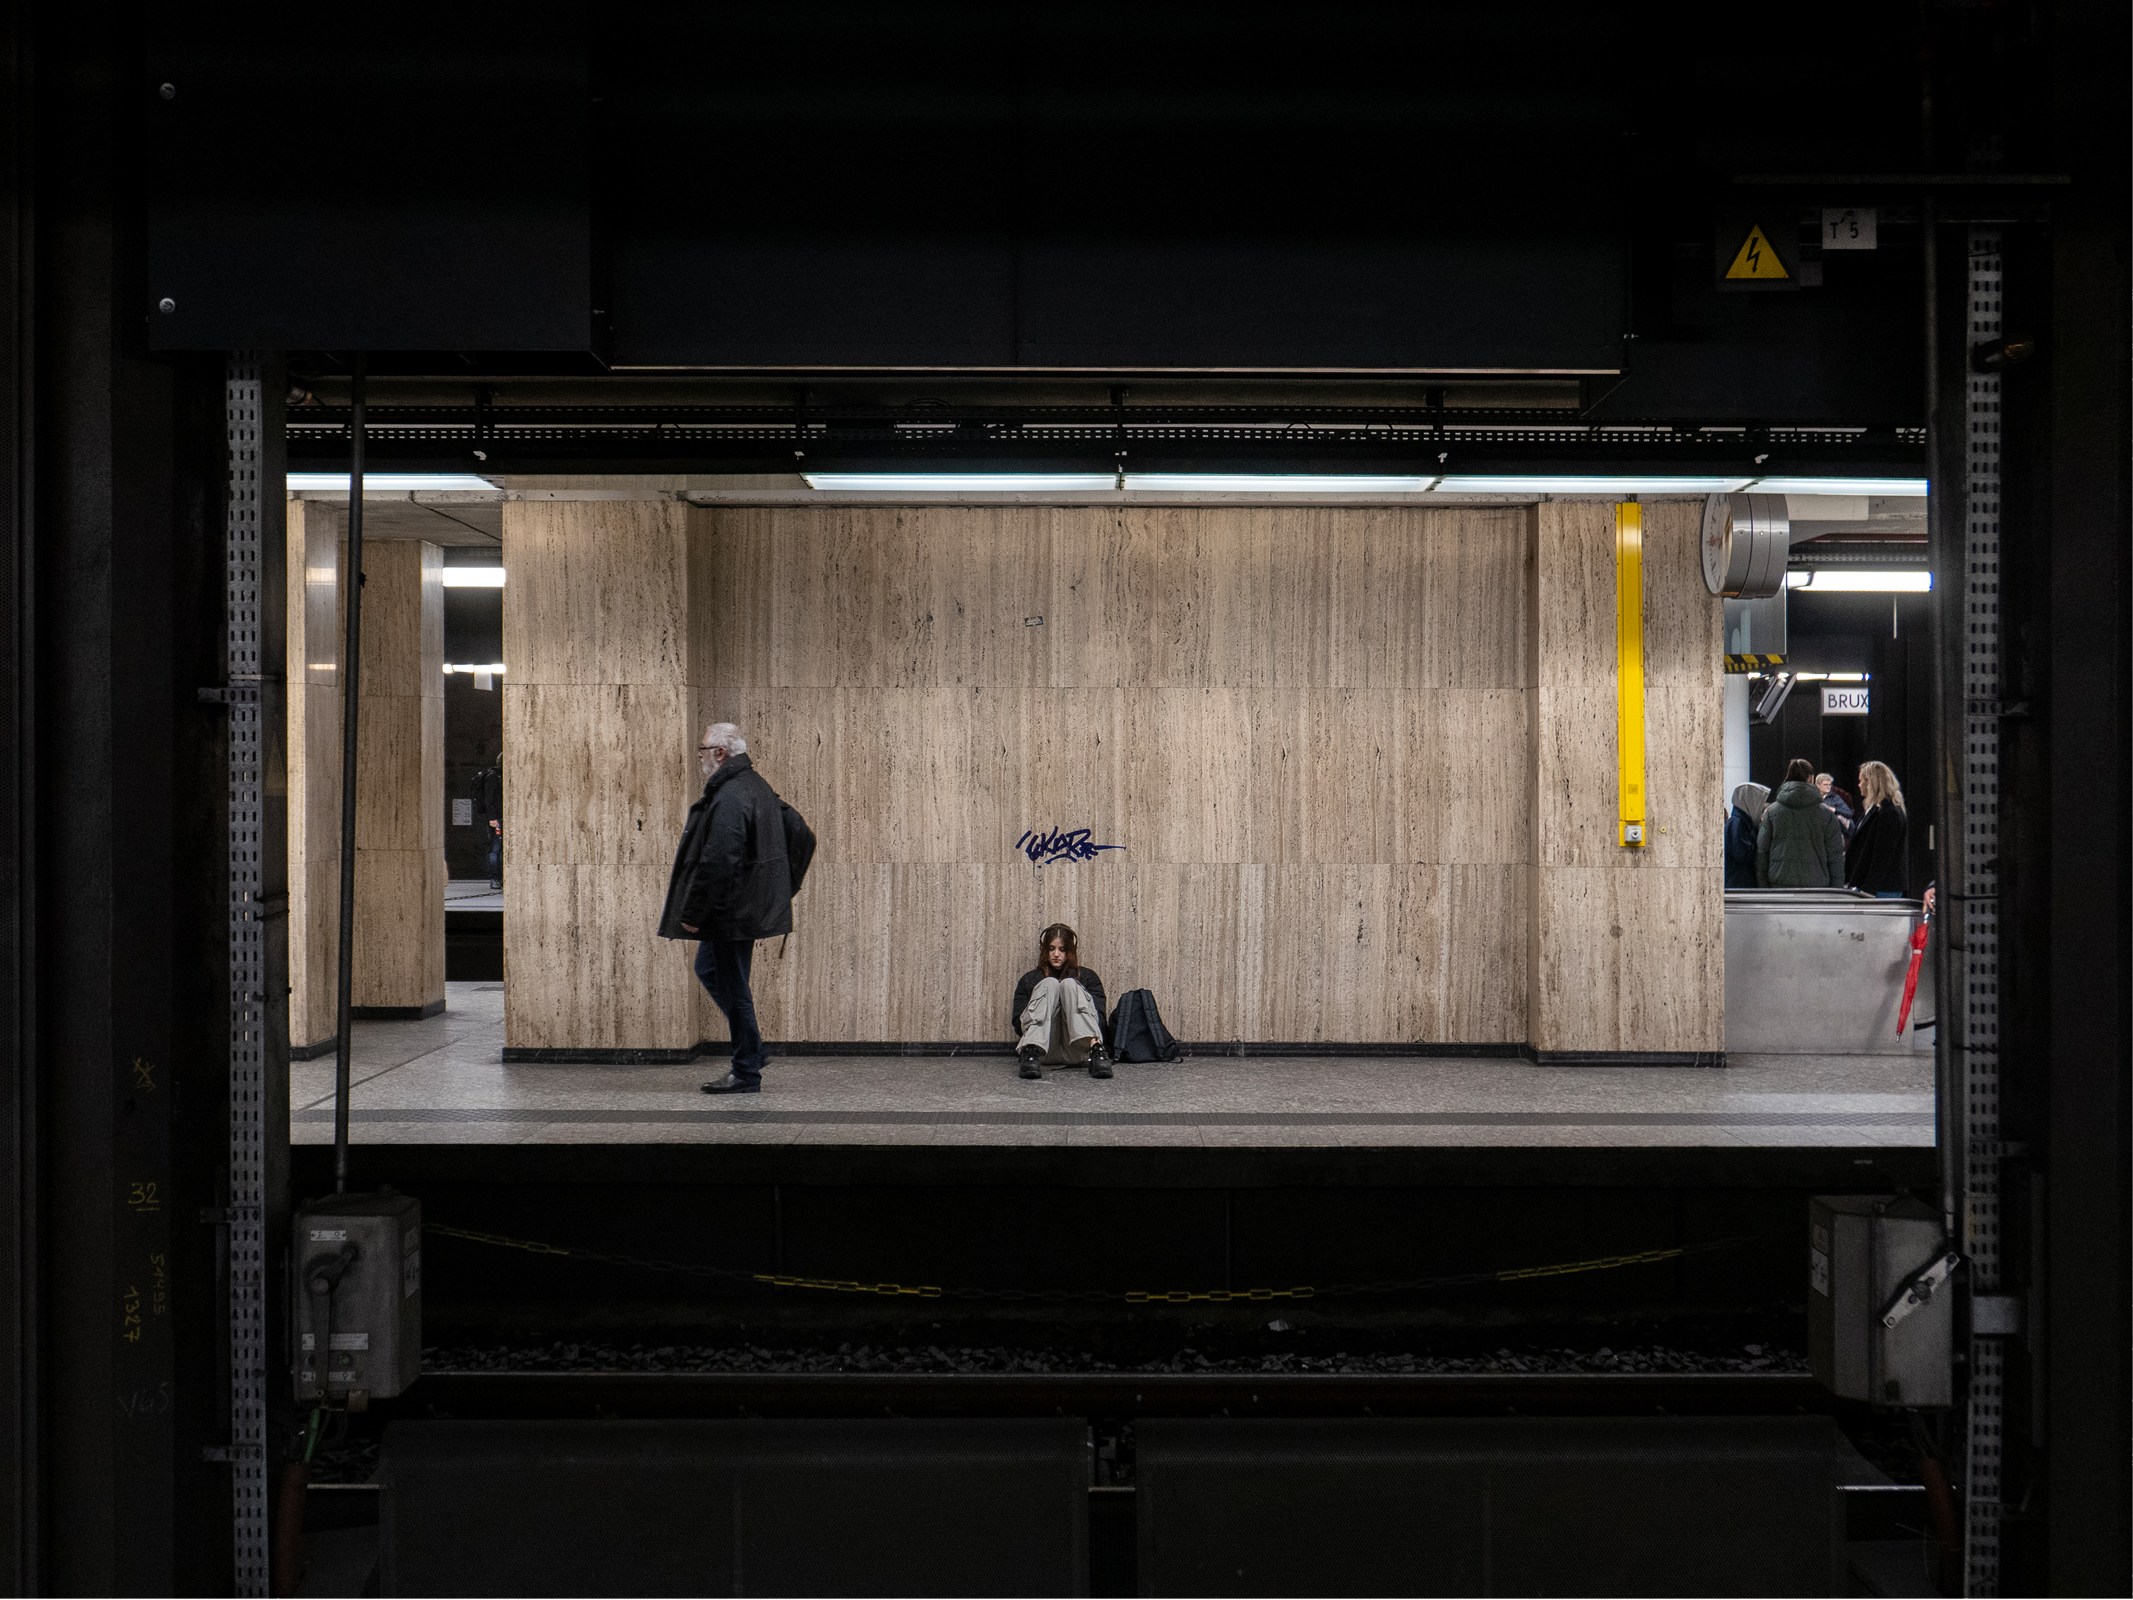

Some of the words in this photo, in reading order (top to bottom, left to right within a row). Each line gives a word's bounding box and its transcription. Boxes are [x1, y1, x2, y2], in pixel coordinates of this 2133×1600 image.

[1850, 222, 1858, 239] 5
[1828, 693, 1868, 709] BRUX
[127, 1181, 160, 1205] 32
[123, 1284, 142, 1344] 1327
